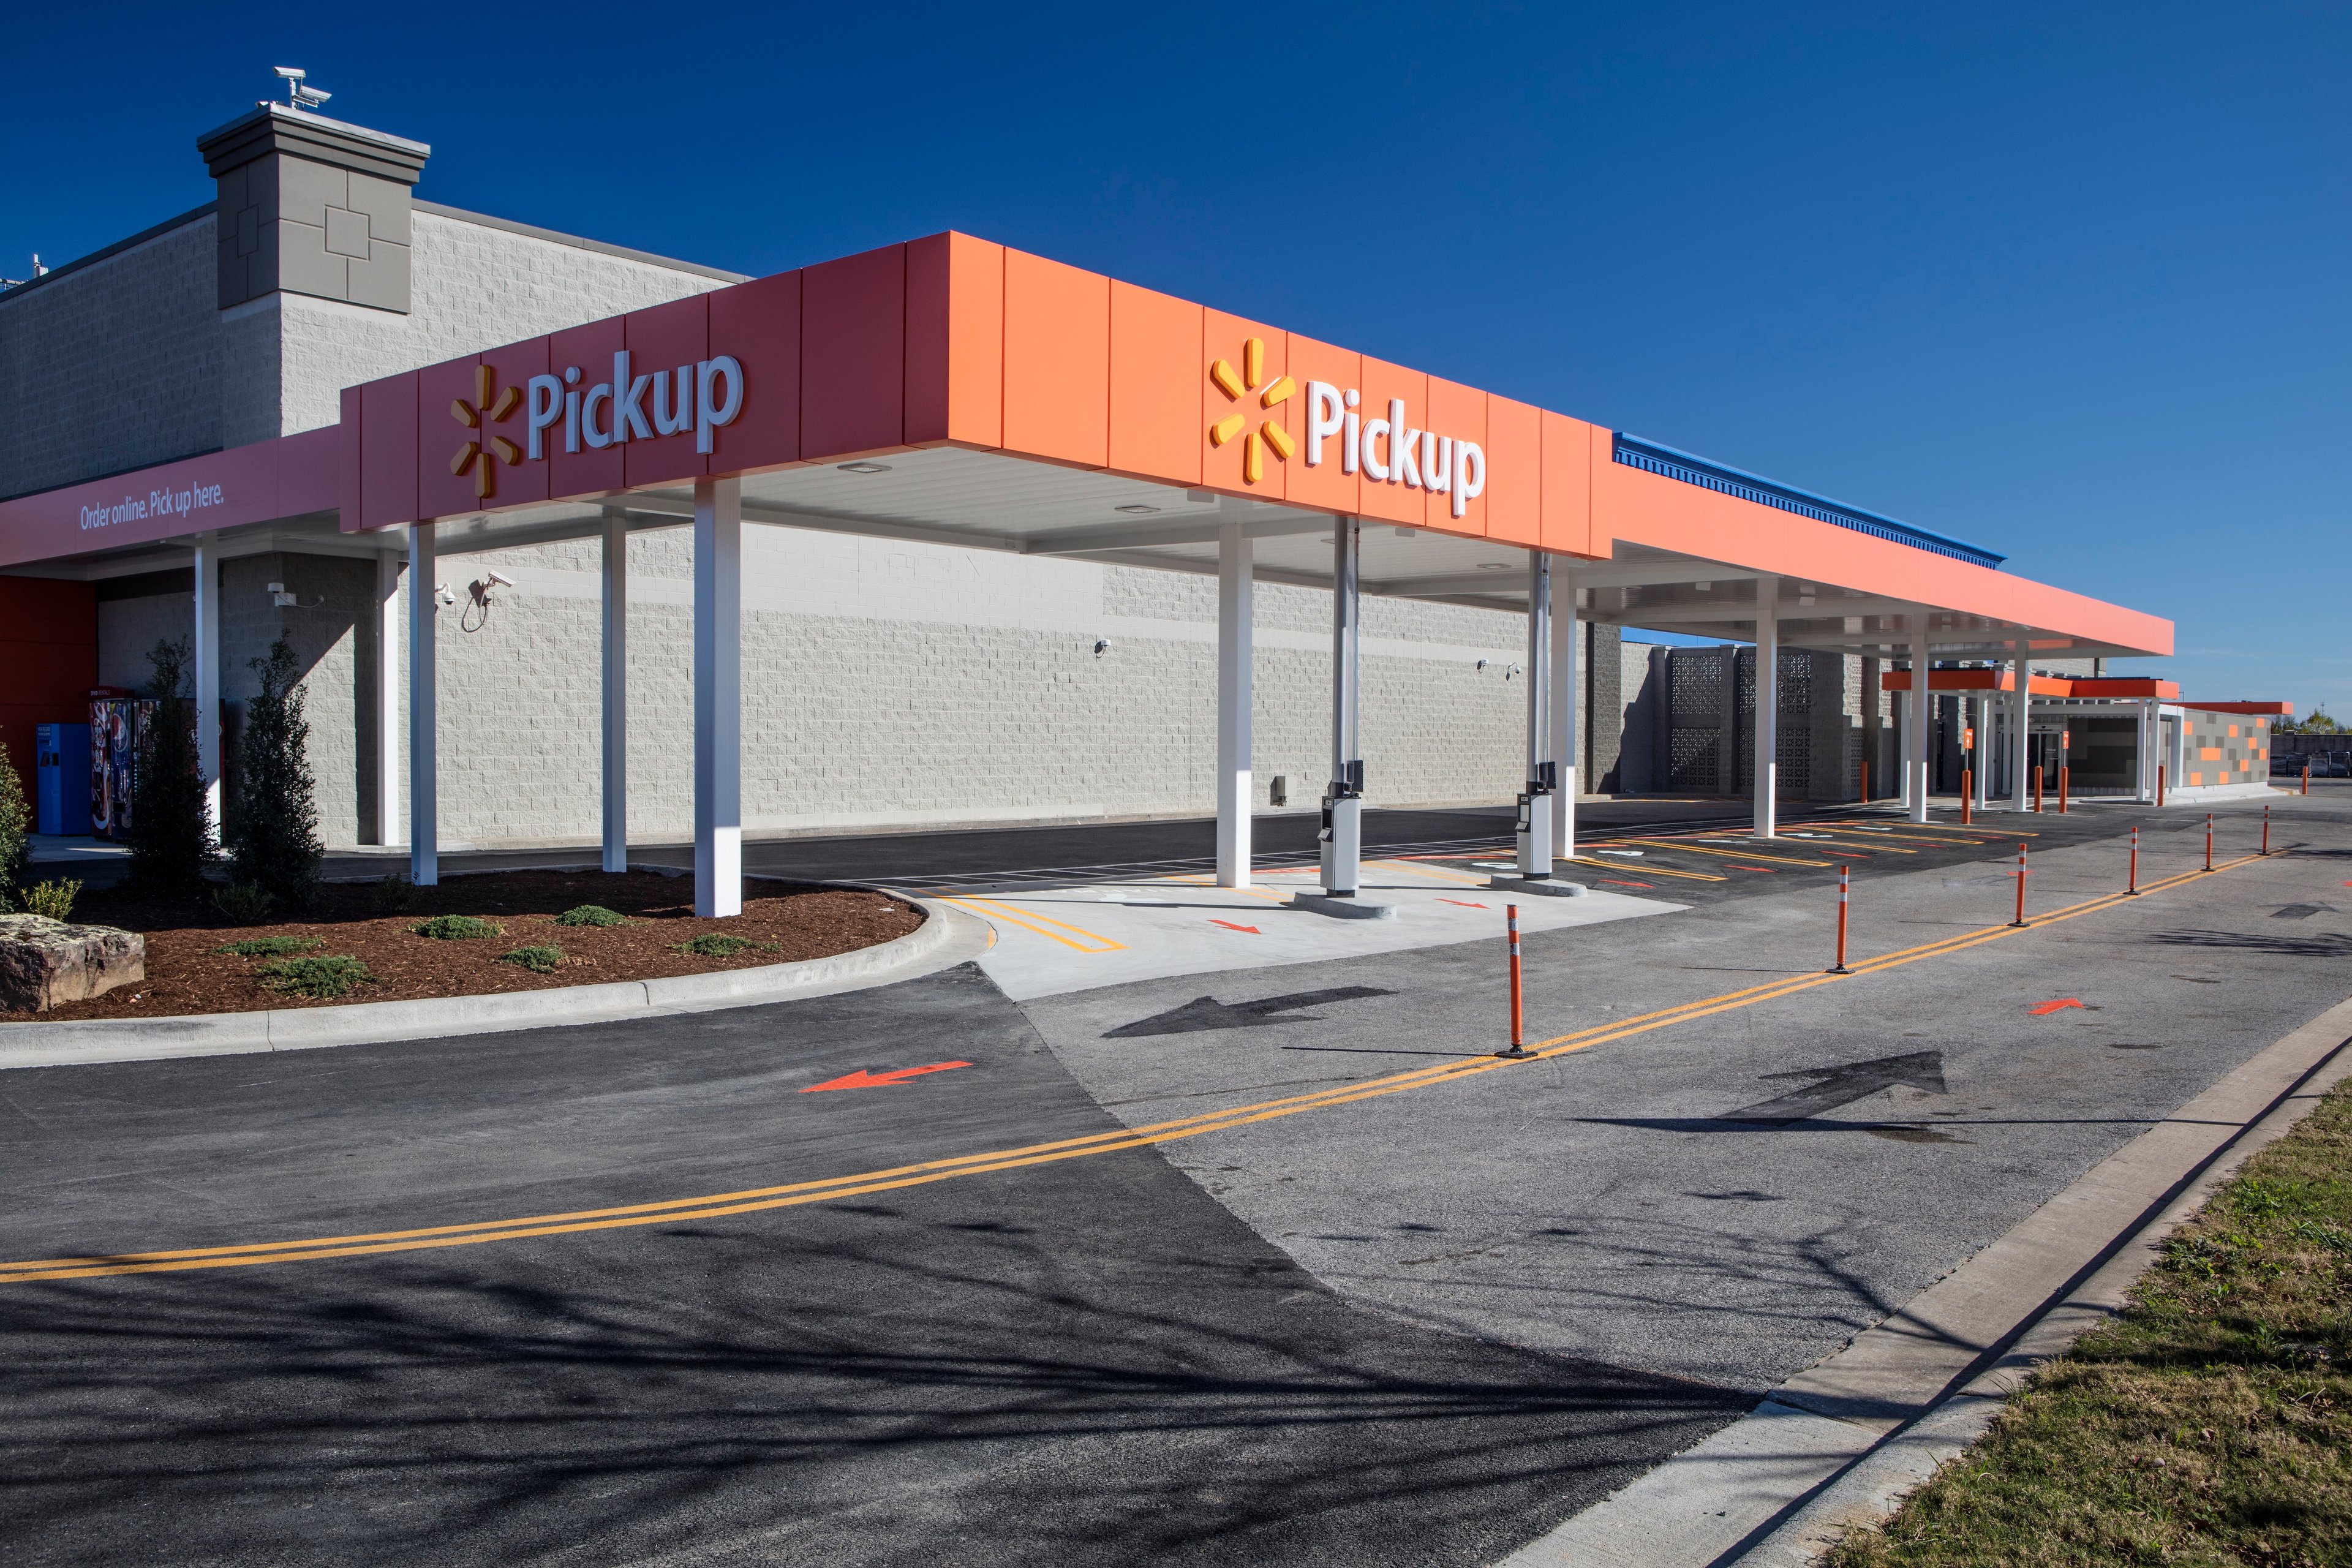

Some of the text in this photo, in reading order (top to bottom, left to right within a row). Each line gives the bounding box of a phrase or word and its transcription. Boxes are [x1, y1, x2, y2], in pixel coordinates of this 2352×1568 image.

[529, 350, 745, 455] Pickup
[1306, 380, 1486, 516] Pickup
[80, 481, 224, 530] Order online. Pick up here.
